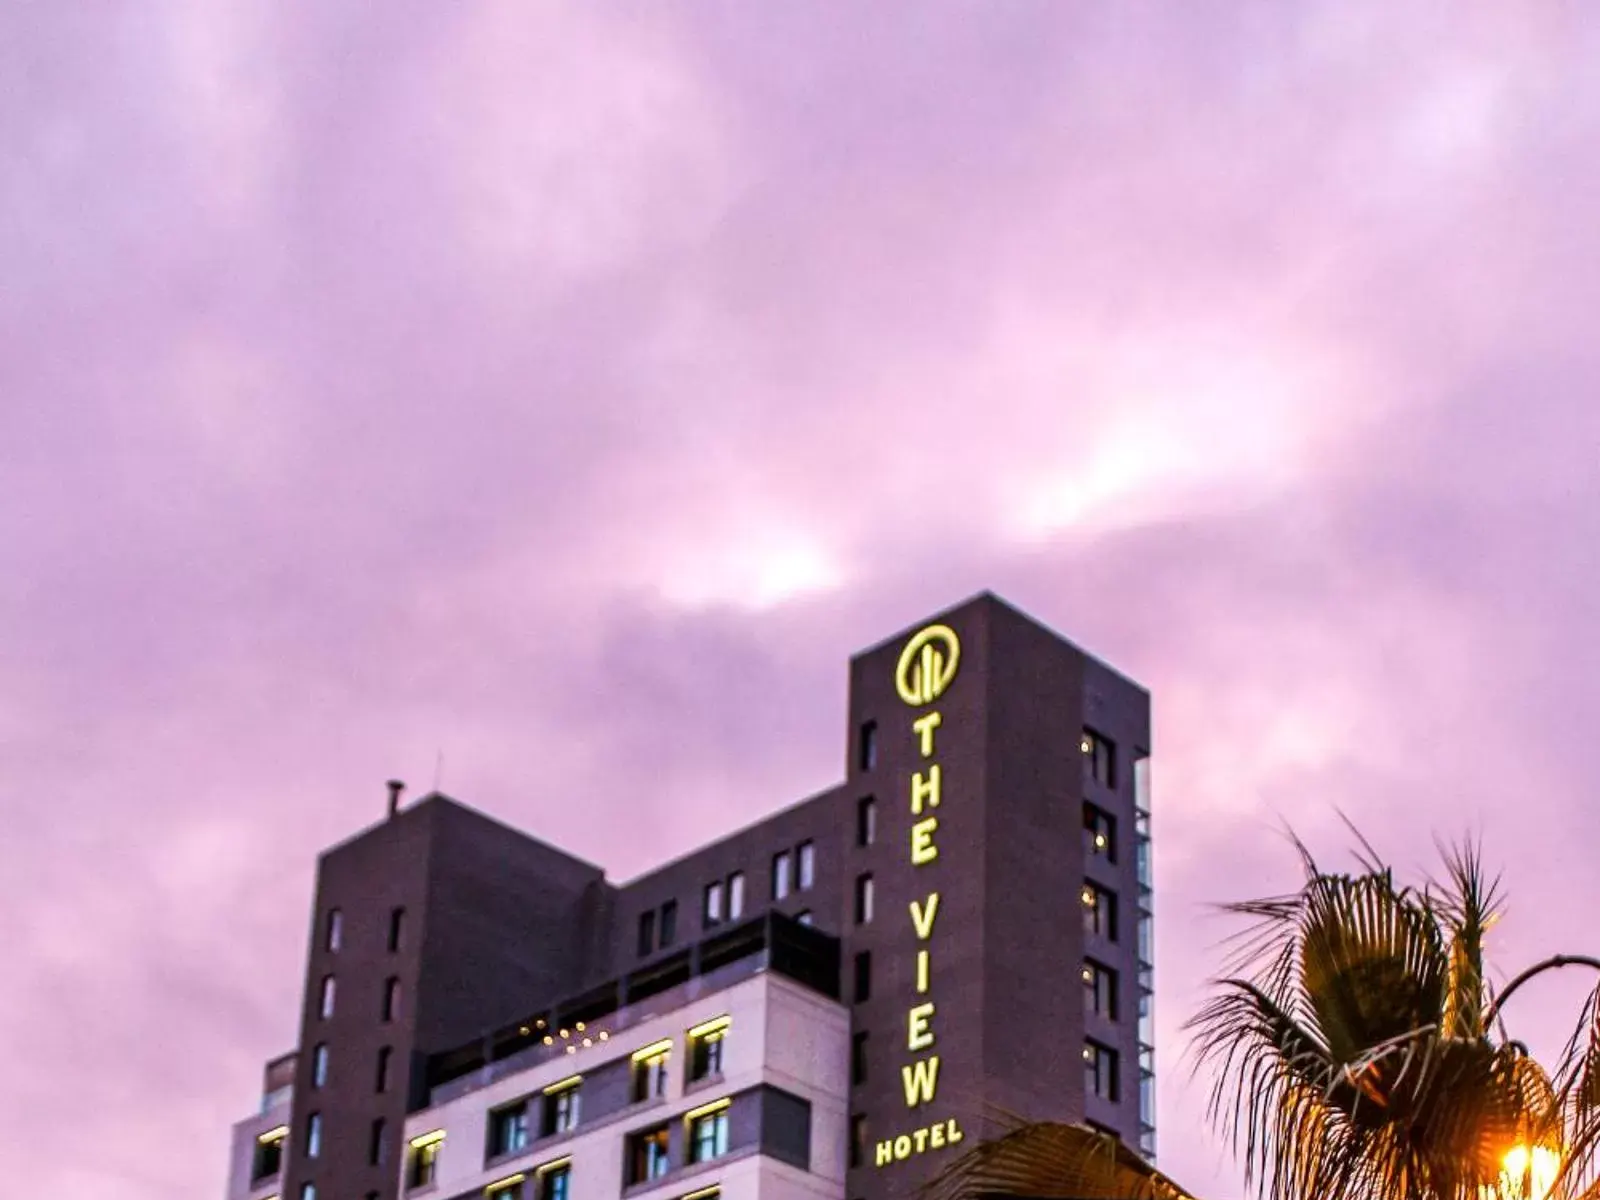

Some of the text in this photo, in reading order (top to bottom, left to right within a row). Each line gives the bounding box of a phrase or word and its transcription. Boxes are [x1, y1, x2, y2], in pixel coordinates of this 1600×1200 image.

[901, 711, 941, 1107] THE VIEW
[875, 1118, 963, 1167] HOTEL
